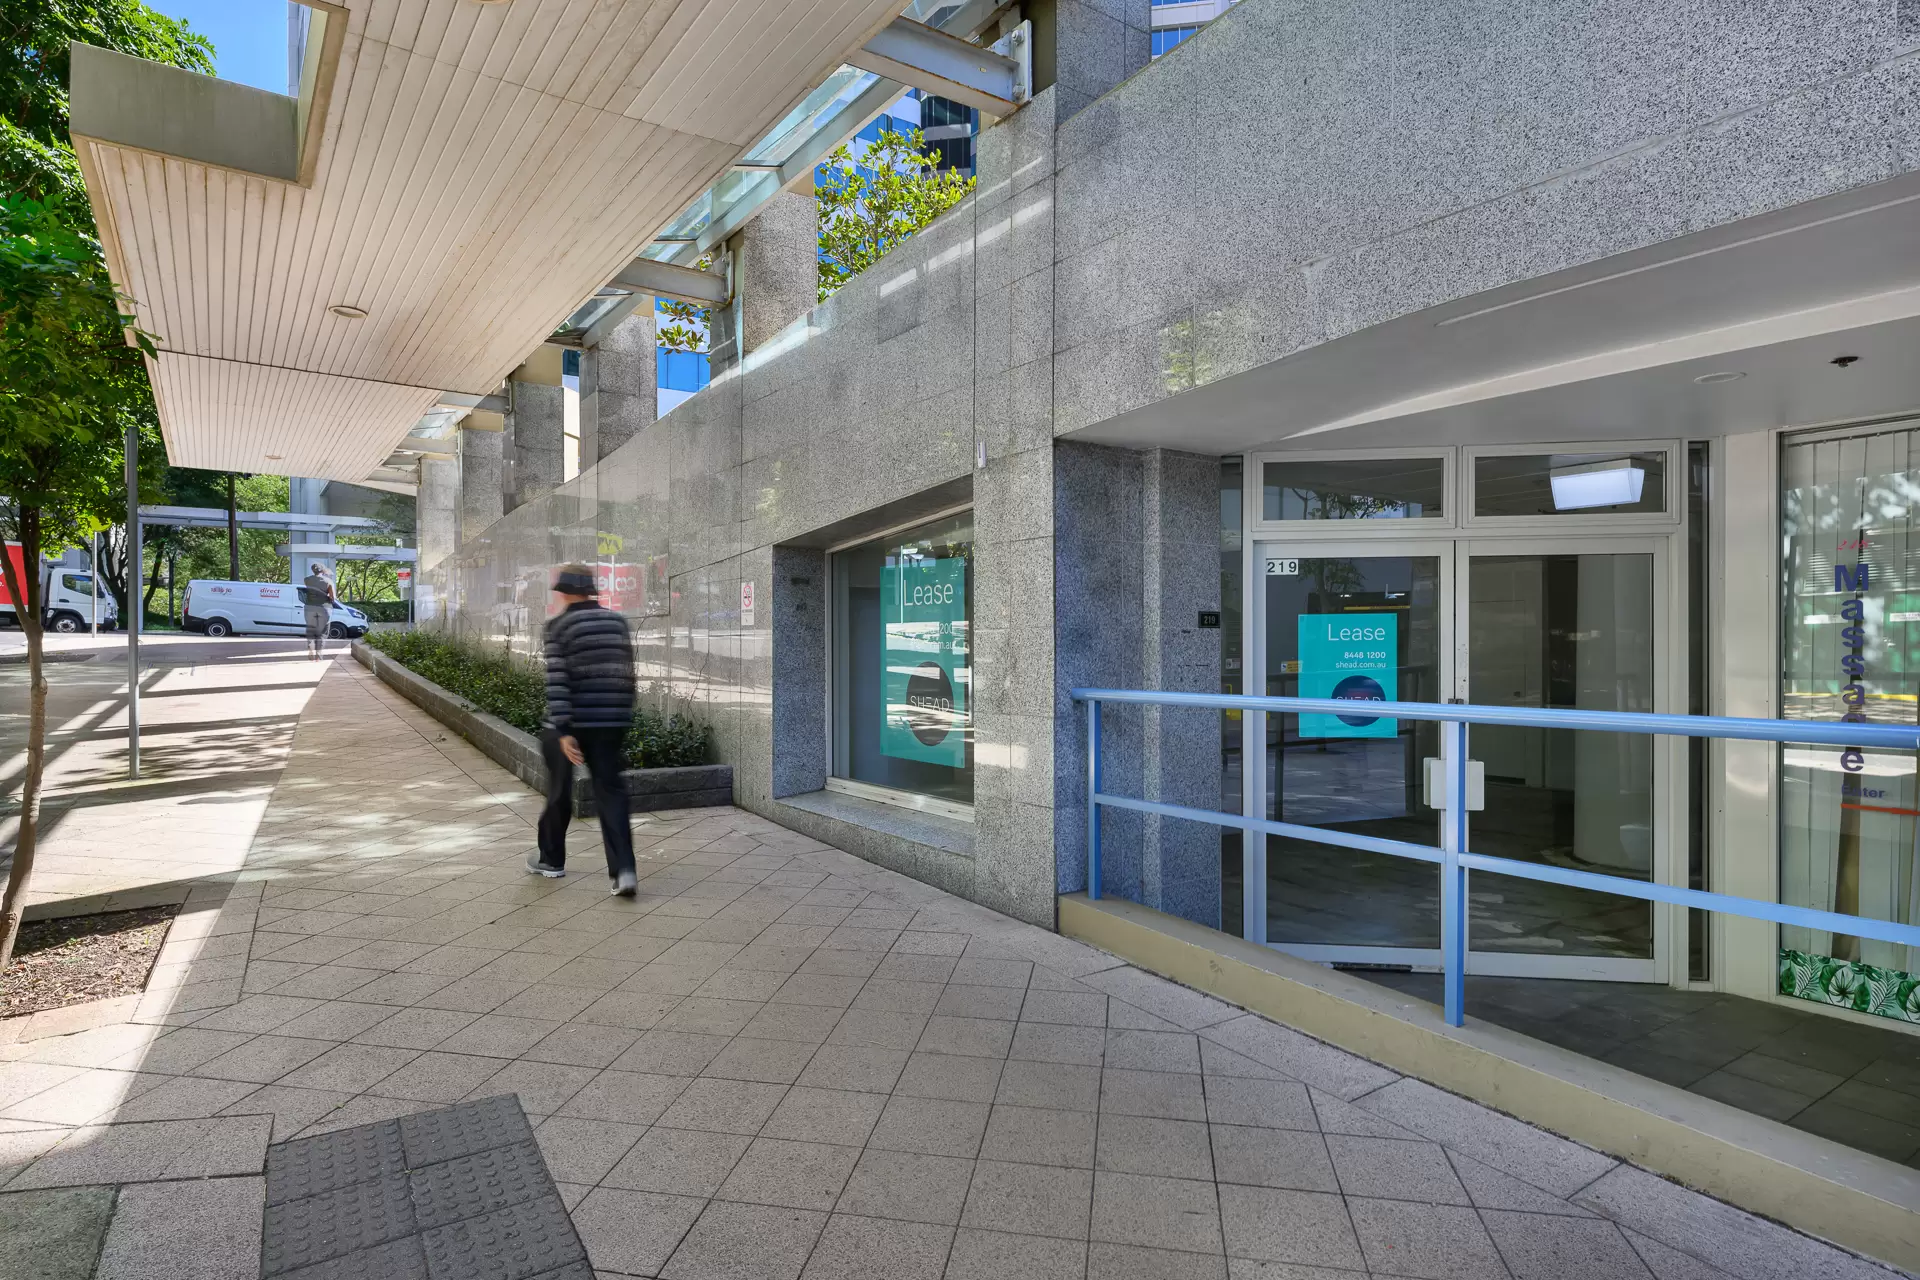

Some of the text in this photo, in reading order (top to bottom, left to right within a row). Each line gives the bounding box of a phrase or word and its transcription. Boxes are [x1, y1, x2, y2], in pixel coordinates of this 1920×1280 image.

[1267, 561, 1297, 573] 219
[903, 579, 954, 606] Lease
[1327, 623, 1386, 641] Lease
[1343, 651, 1386, 659] 8448 1200
[1335, 661, 1386, 669] shead.com.au
[910, 695, 950, 712] SHEAD
[1842, 784, 1886, 799] Enter
